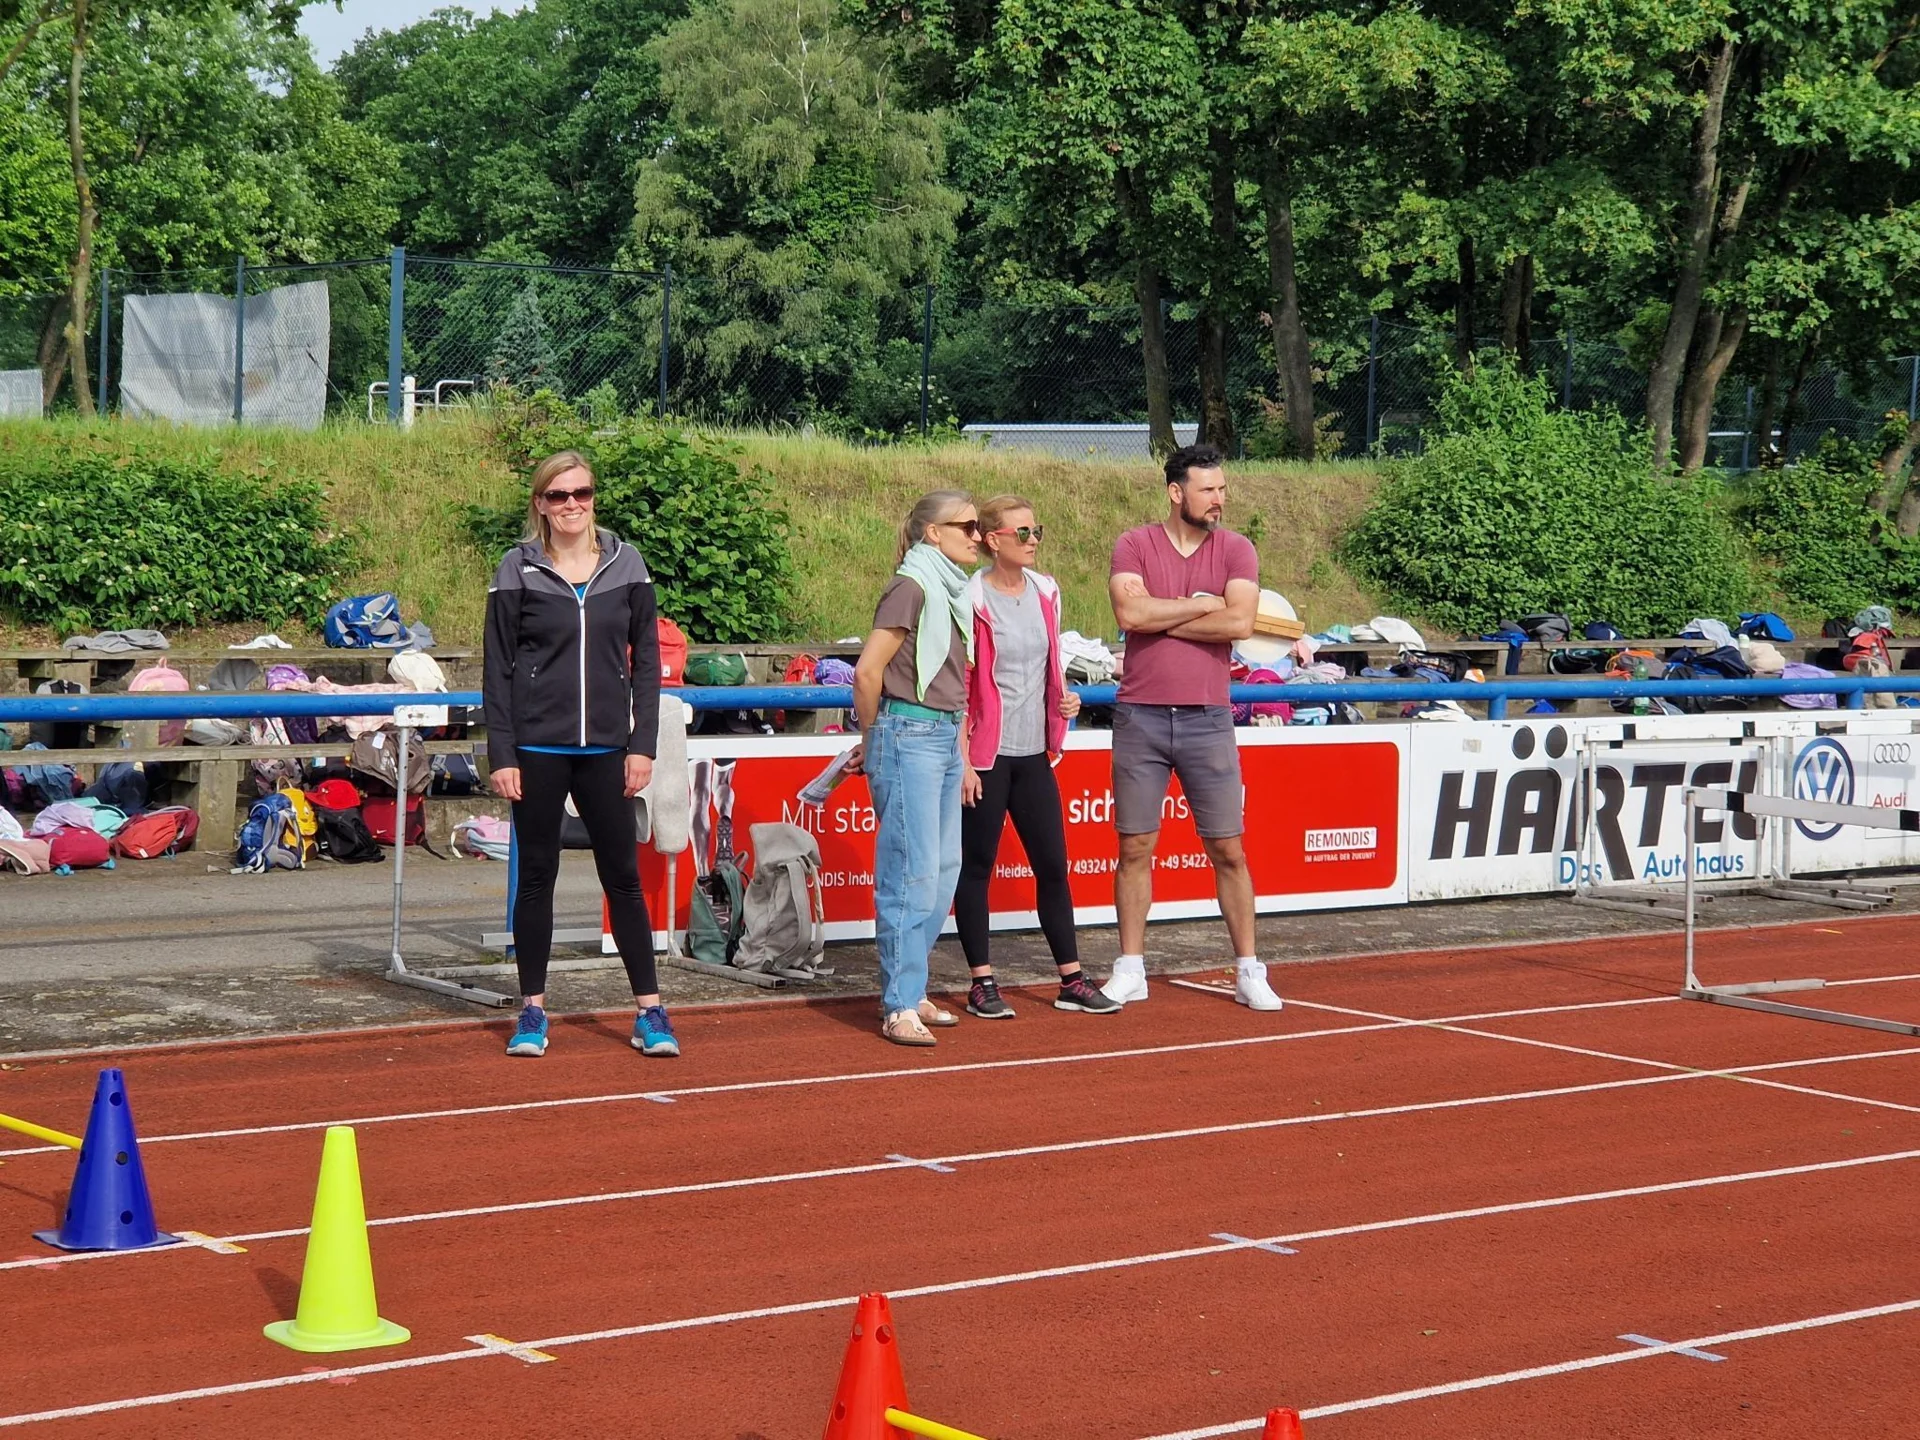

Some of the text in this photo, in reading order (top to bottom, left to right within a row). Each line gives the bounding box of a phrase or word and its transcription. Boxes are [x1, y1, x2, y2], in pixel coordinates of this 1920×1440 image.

[1873, 793, 1908, 808] Audi
[782, 799, 826, 834] Mit
[1307, 830, 1370, 849] REMONDIS
[1074, 858, 1107, 875] 49324
[1159, 854, 1180, 870] +49
[1181, 853, 1208, 869] 5422
[1304, 851, 1376, 863] IM AUFTRAG DER ZUKUNFT
